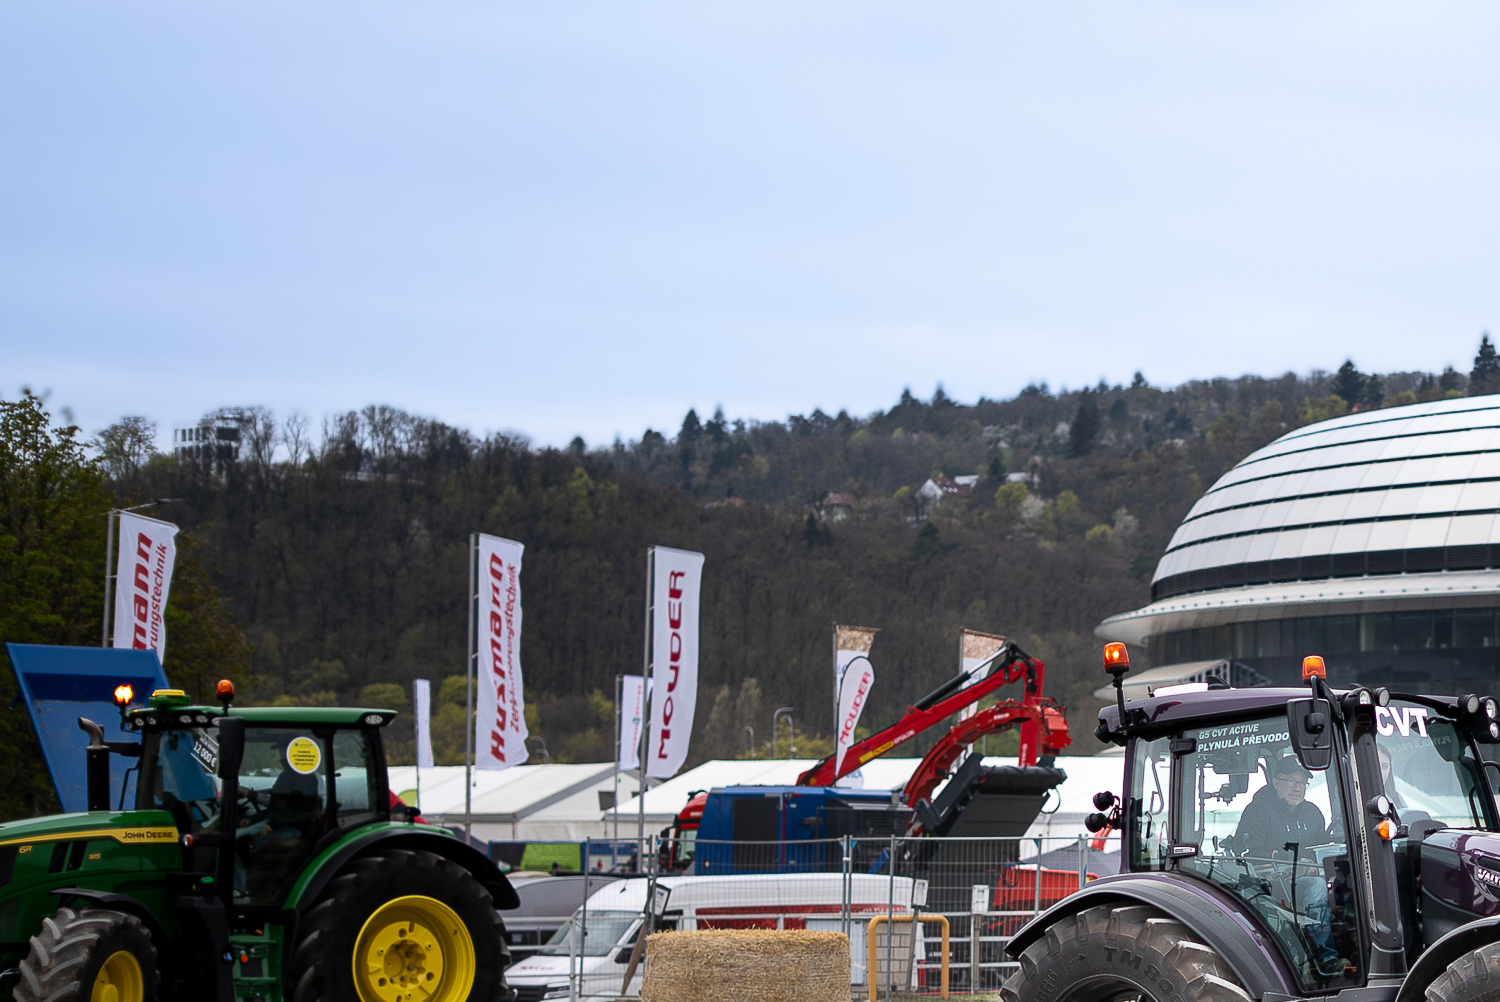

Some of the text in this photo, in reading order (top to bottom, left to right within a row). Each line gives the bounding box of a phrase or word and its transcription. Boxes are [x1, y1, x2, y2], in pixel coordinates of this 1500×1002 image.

[132, 532, 153, 650] mann
[658, 570, 686, 759] MOUDER
[839, 671, 872, 745] MOUDER
[1198, 723, 1259, 740] G5 CVT ACTIVE
[1375, 705, 1428, 738] CVT
[193, 741, 201, 755] 12
[1198, 731, 1290, 752] PLYNULÁ PŘEVODO
[123, 831, 173, 839] JOHN DEERE
[19, 845, 32, 854] 6R
